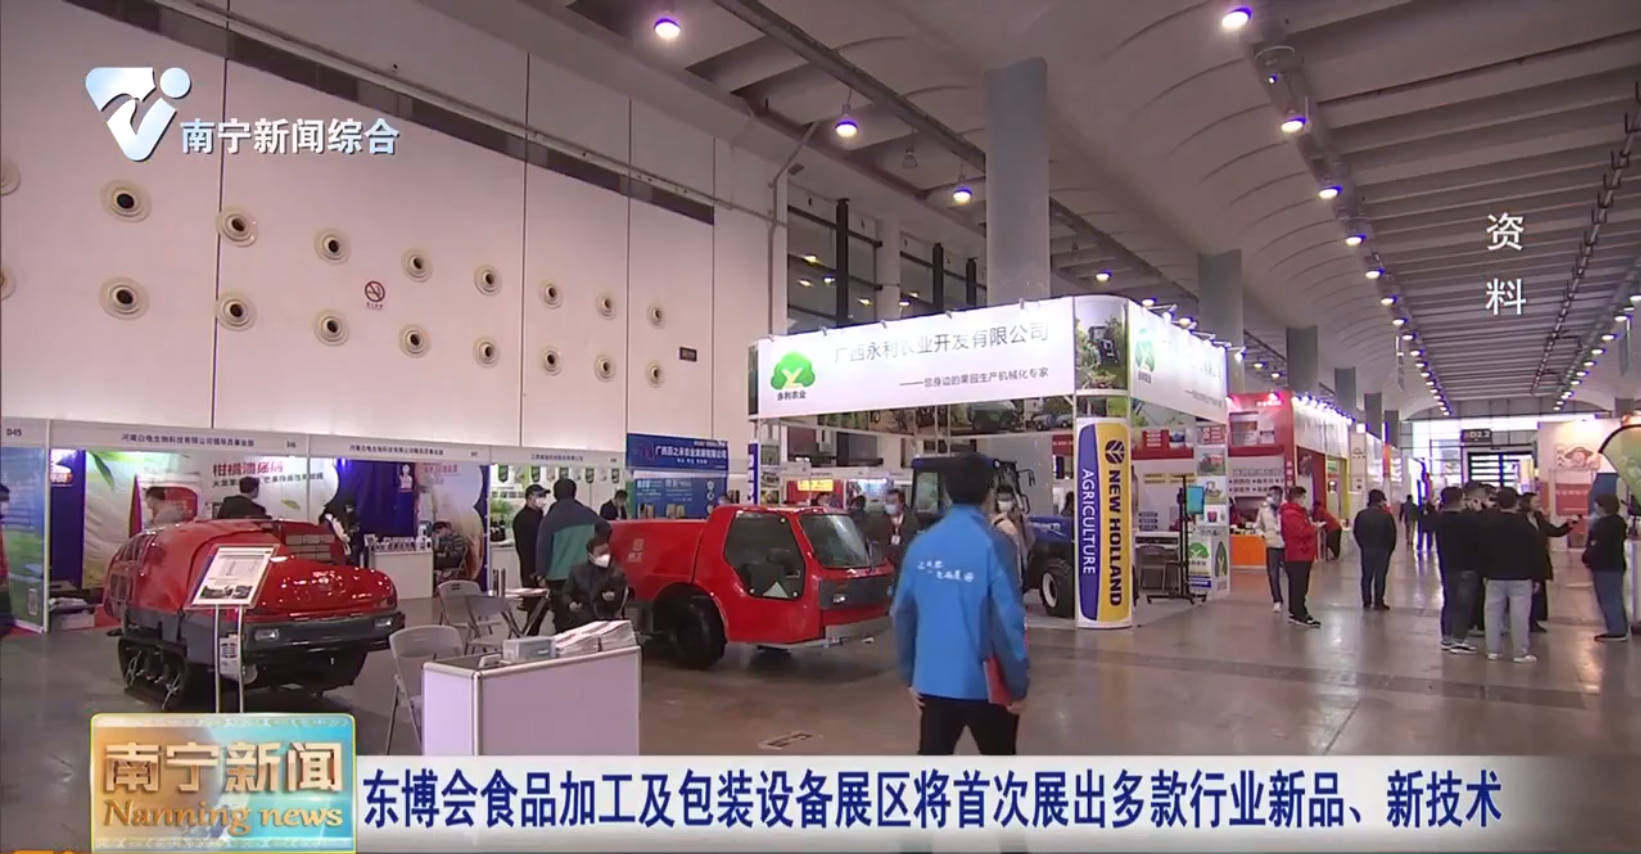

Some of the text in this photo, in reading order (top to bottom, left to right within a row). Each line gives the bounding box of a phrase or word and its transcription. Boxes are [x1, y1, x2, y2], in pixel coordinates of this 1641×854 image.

[1082, 468, 1096, 575] AGRICULTURE
[1109, 469, 1122, 607] NEW HOLLAND
